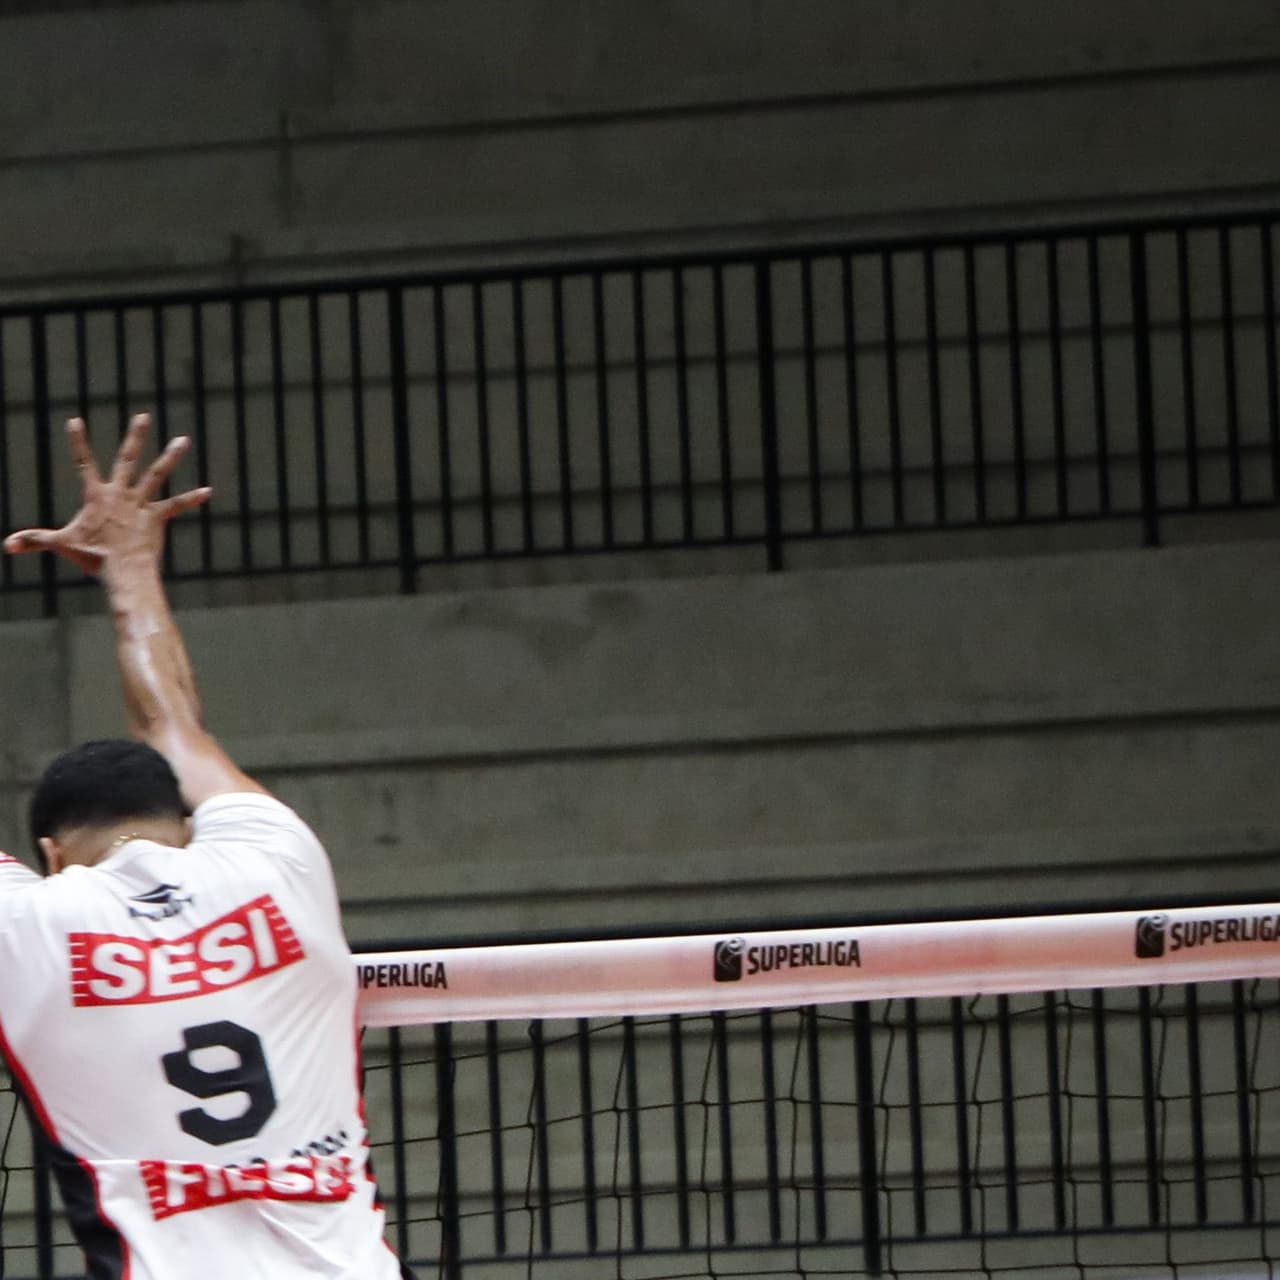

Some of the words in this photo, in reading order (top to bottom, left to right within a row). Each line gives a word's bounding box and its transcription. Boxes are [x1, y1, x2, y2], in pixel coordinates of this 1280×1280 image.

[90, 908, 280, 1000] SESI
[747, 939, 861, 975] SUPERLIGA
[160, 1019, 278, 1147] 9
